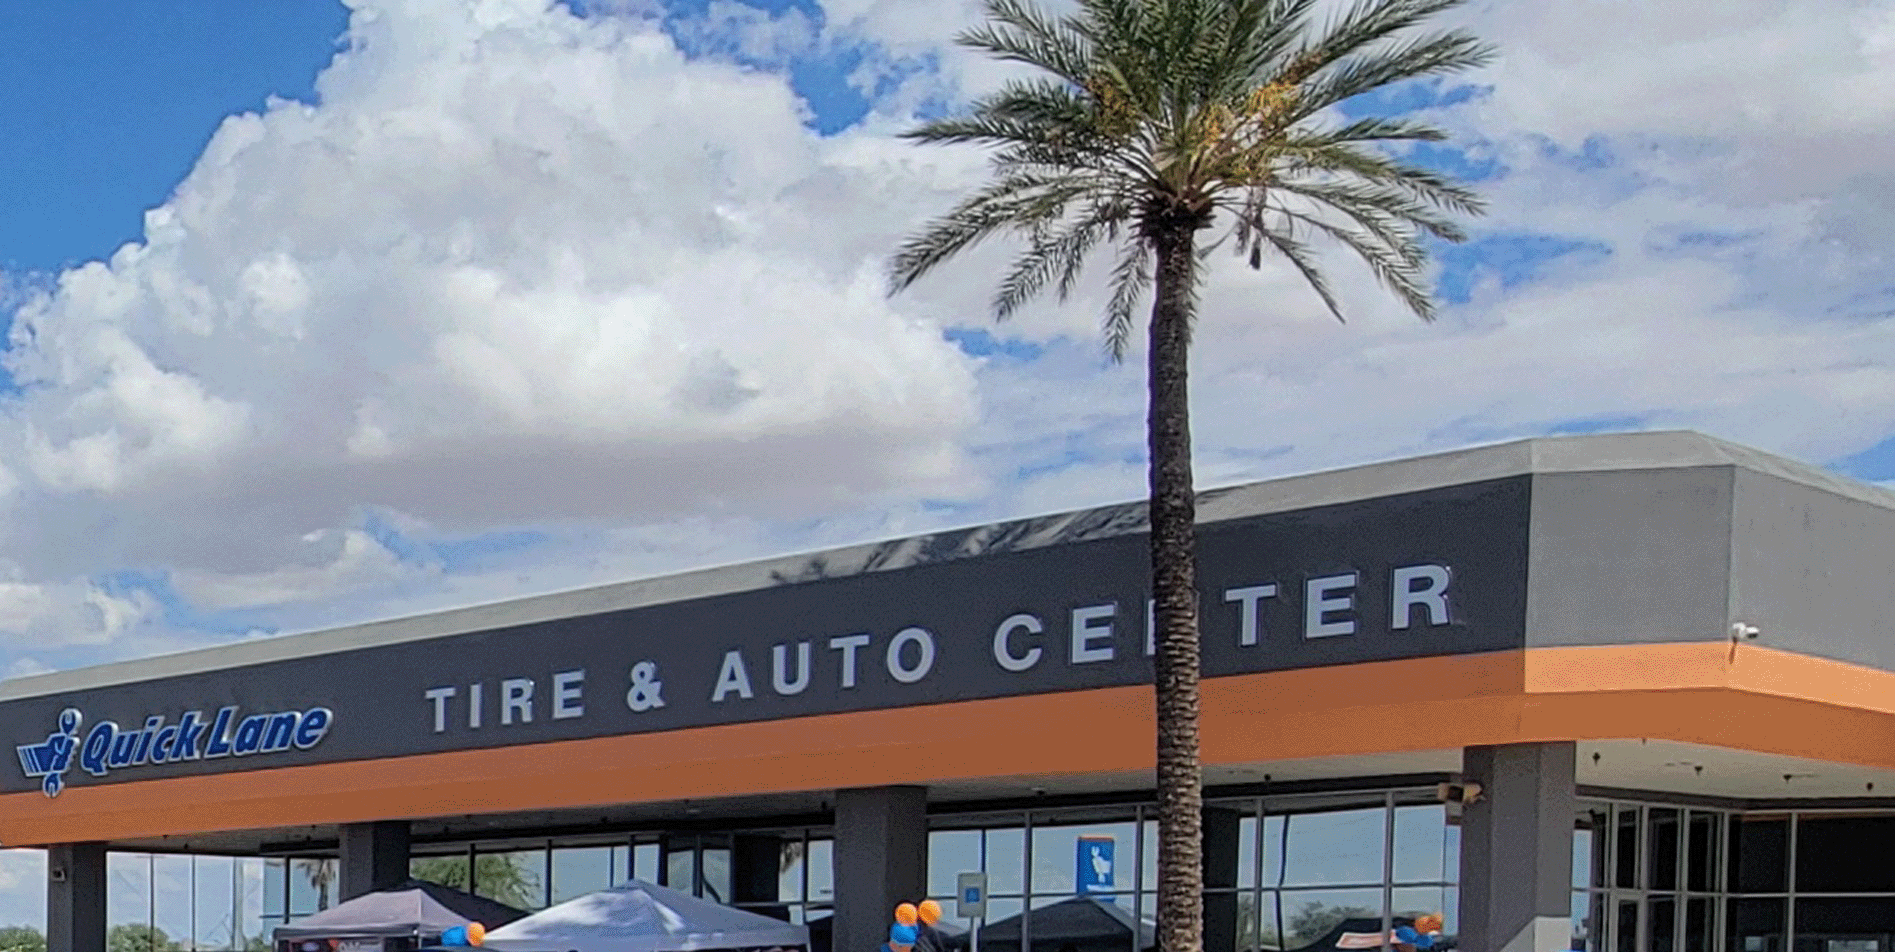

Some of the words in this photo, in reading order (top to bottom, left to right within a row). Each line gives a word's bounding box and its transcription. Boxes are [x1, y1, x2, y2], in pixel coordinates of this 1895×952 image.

[425, 668, 587, 732] TIRE
[626, 659, 666, 712] &
[711, 626, 937, 703] AUTO
[992, 563, 1453, 672] CETER
[80, 711, 207, 777] Quick
[203, 705, 333, 759] Lane
